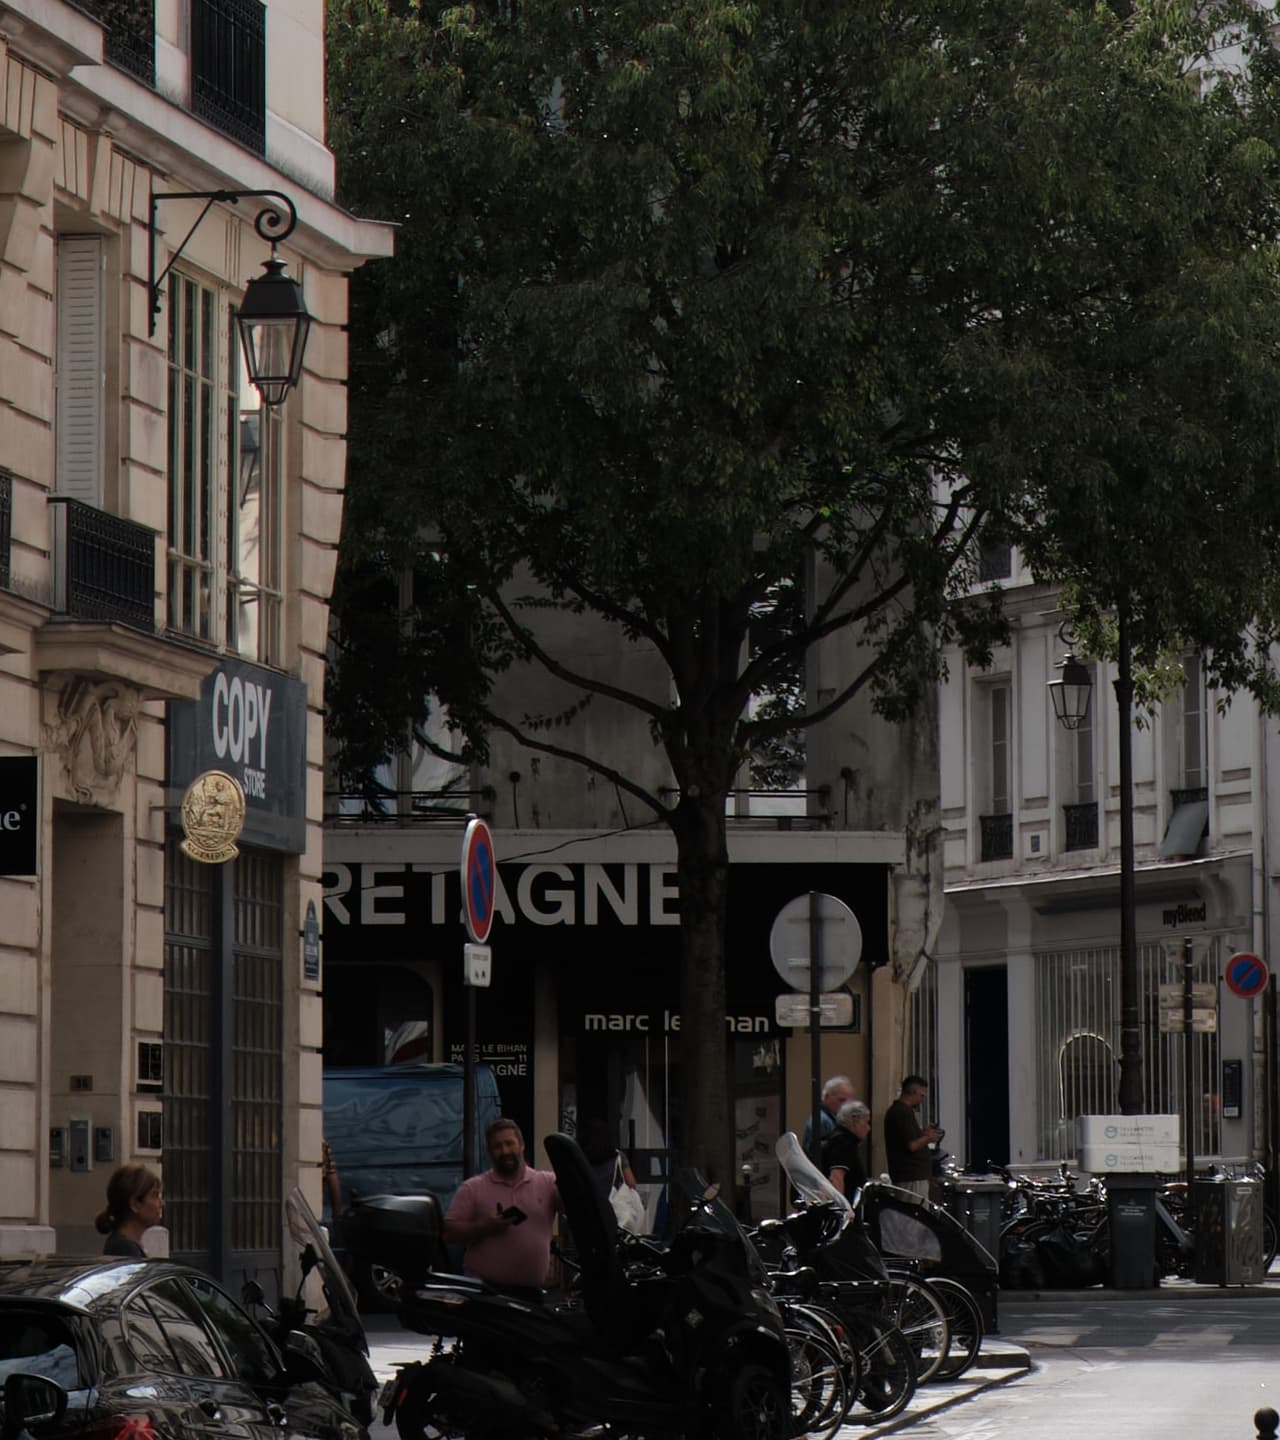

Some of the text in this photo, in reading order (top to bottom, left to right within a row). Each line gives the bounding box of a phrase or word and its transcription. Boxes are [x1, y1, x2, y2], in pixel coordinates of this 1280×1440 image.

[212, 671, 272, 770] COPY
[243, 768, 266, 800] STORE
[583, 1013, 650, 1032] marc
[663, 1009, 681, 1032] le
[450, 1043, 481, 1053] MAC
[481, 1043, 495, 1053] LE
